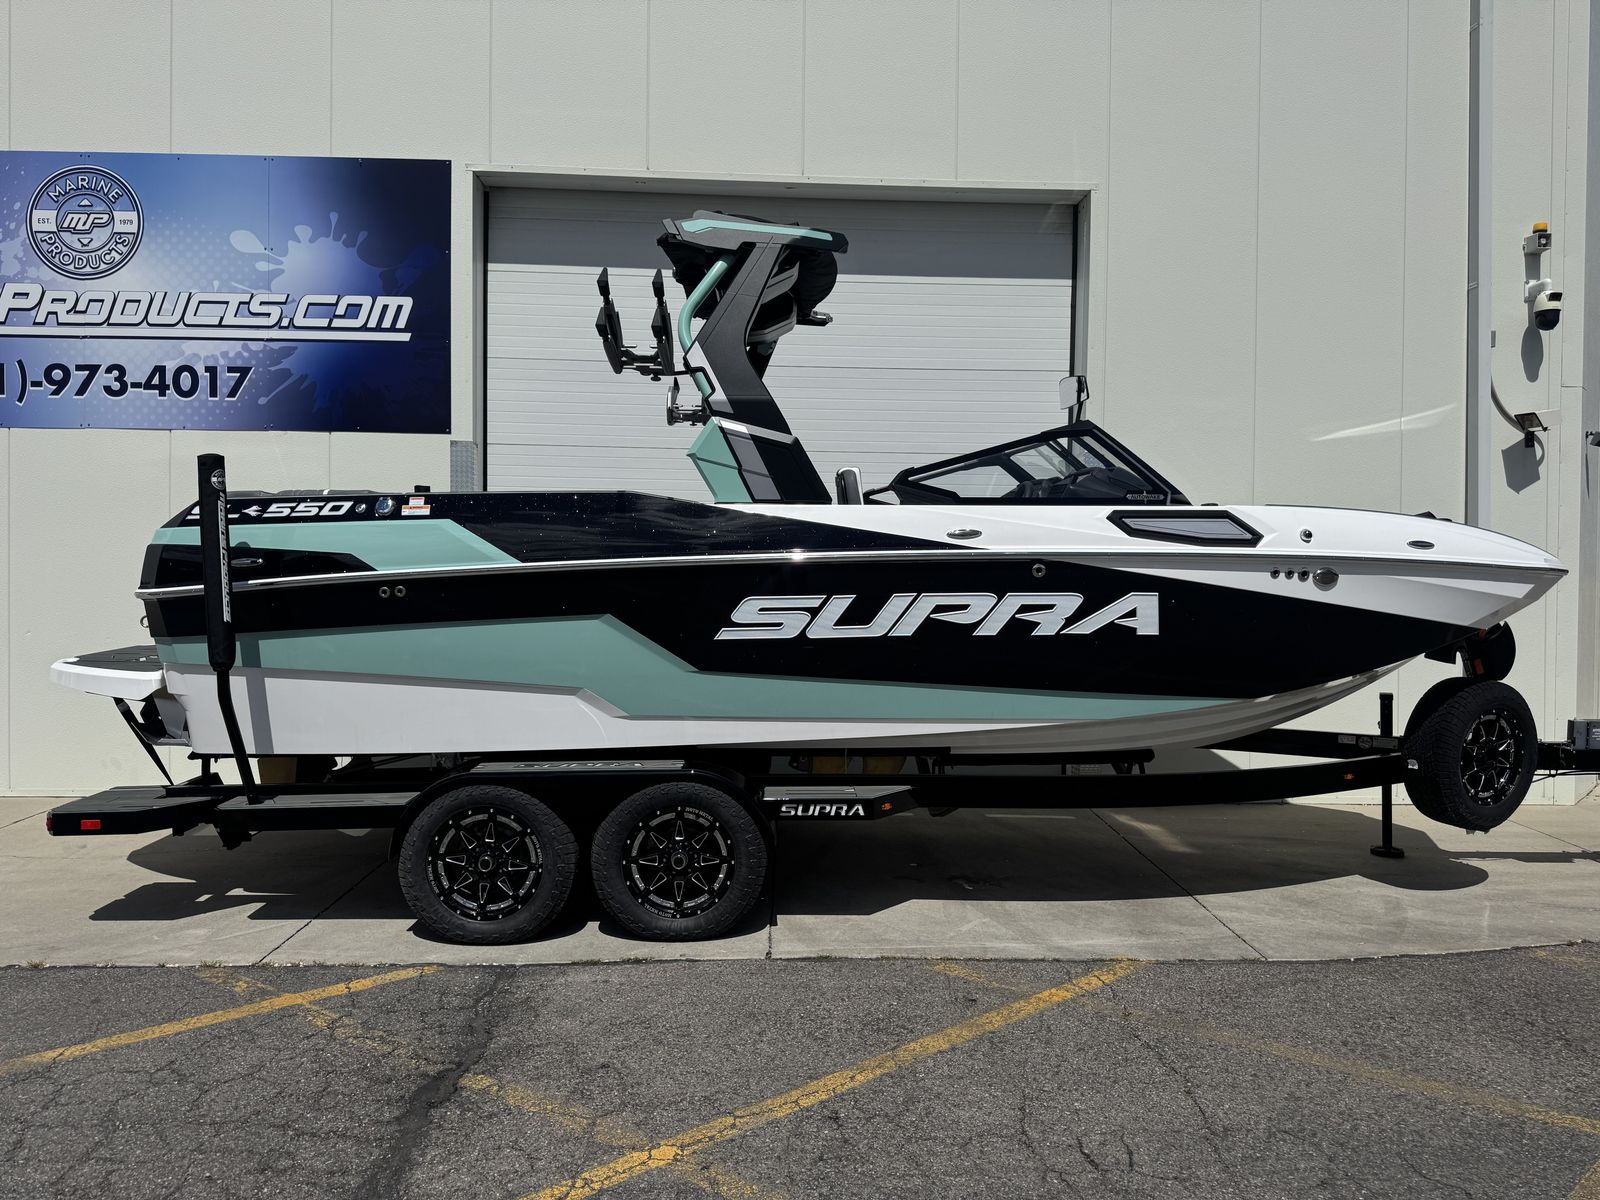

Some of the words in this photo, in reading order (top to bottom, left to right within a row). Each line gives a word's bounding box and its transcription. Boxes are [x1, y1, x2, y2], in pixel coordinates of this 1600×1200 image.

[47, 175, 123, 203] MARINE
[37, 217, 52, 225] EST.
[119, 218, 134, 226] 1979
[40, 233, 130, 269] PRODUCTS
[262, 501, 354, 518] 550
[713, 592, 1160, 640] SUPRA
[779, 803, 865, 816] SUPRA
